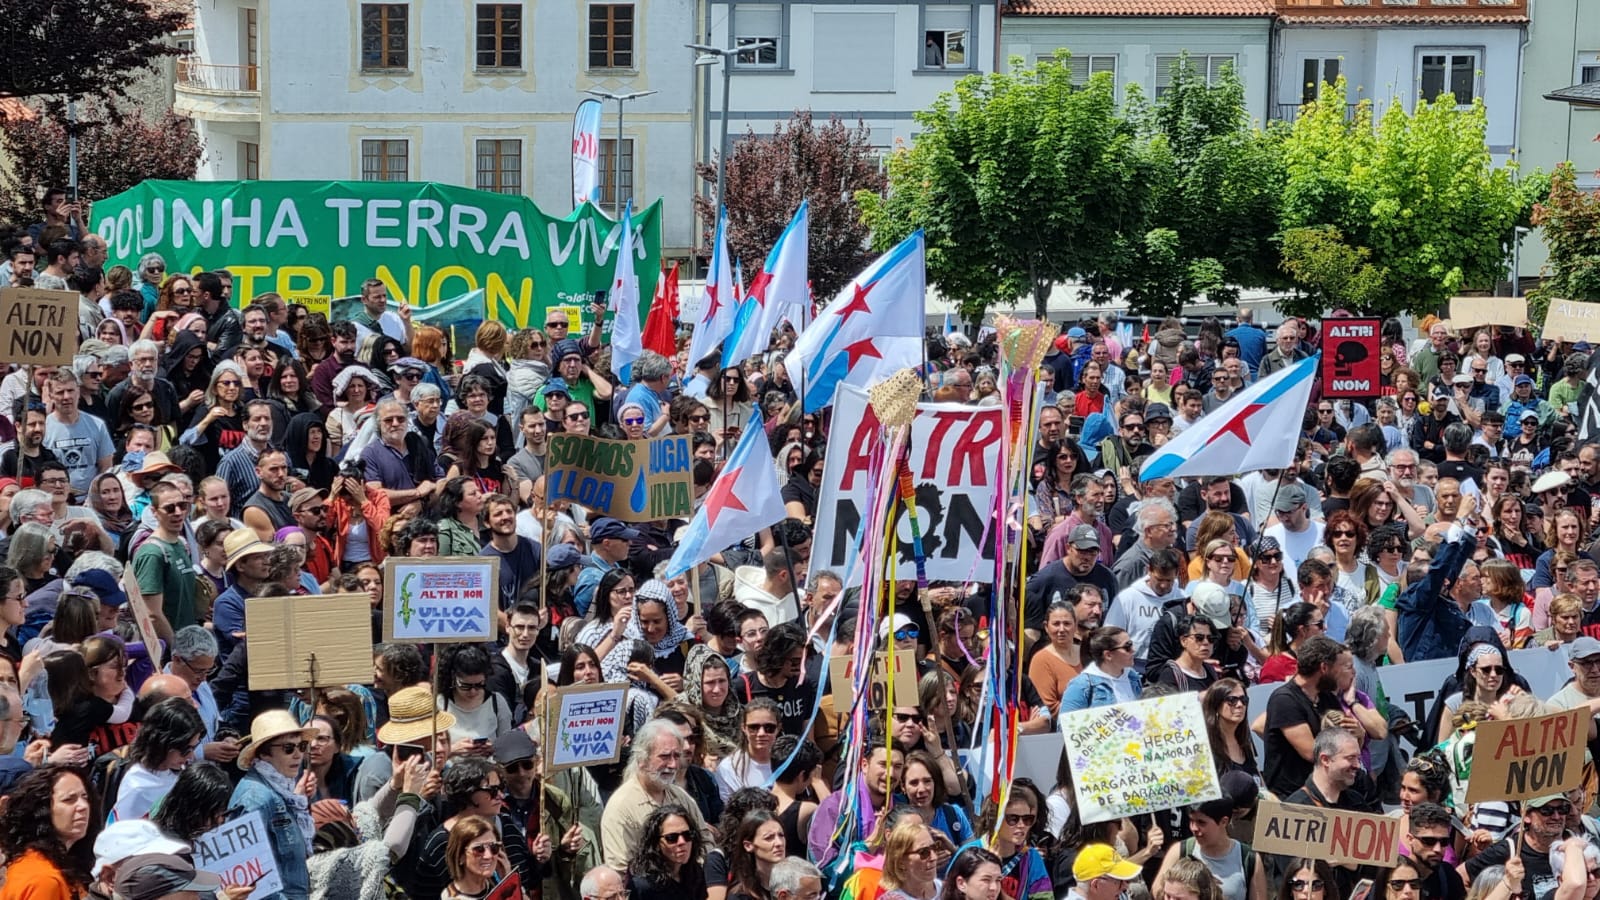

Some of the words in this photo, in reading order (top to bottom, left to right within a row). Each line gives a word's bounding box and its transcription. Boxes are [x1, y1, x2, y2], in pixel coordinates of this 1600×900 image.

[325, 199, 531, 261] TERRA
[314, 297, 328, 305] NON
[6, 302, 66, 327] ALTRI
[1329, 326, 1374, 338] ALTRI
[9, 329, 63, 356] NON
[1332, 379, 1370, 392] NOM
[549, 435, 636, 478] SOMOS
[420, 589, 458, 599] ALTRI
[463, 589, 483, 599] NON
[419, 606, 485, 618] ULLOA
[419, 619, 482, 633] VIVA
[567, 718, 595, 728] ALTRI
[1070, 707, 1121, 748] SANTOLINA
[573, 730, 614, 744] ULLOA
[1143, 729, 1197, 748] HERBA
[1494, 712, 1578, 760] ALTRI
[572, 742, 611, 757] VIVA
[1081, 744, 1096, 757] DE
[1123, 757, 1138, 767] DE
[1143, 743, 1203, 763] NAMORAR
[1505, 752, 1568, 795] NON
[1097, 795, 1113, 806] DE
[199, 821, 259, 867] ALTRI
[1264, 816, 1327, 844] ALTRI
[1329, 816, 1396, 863] NON
